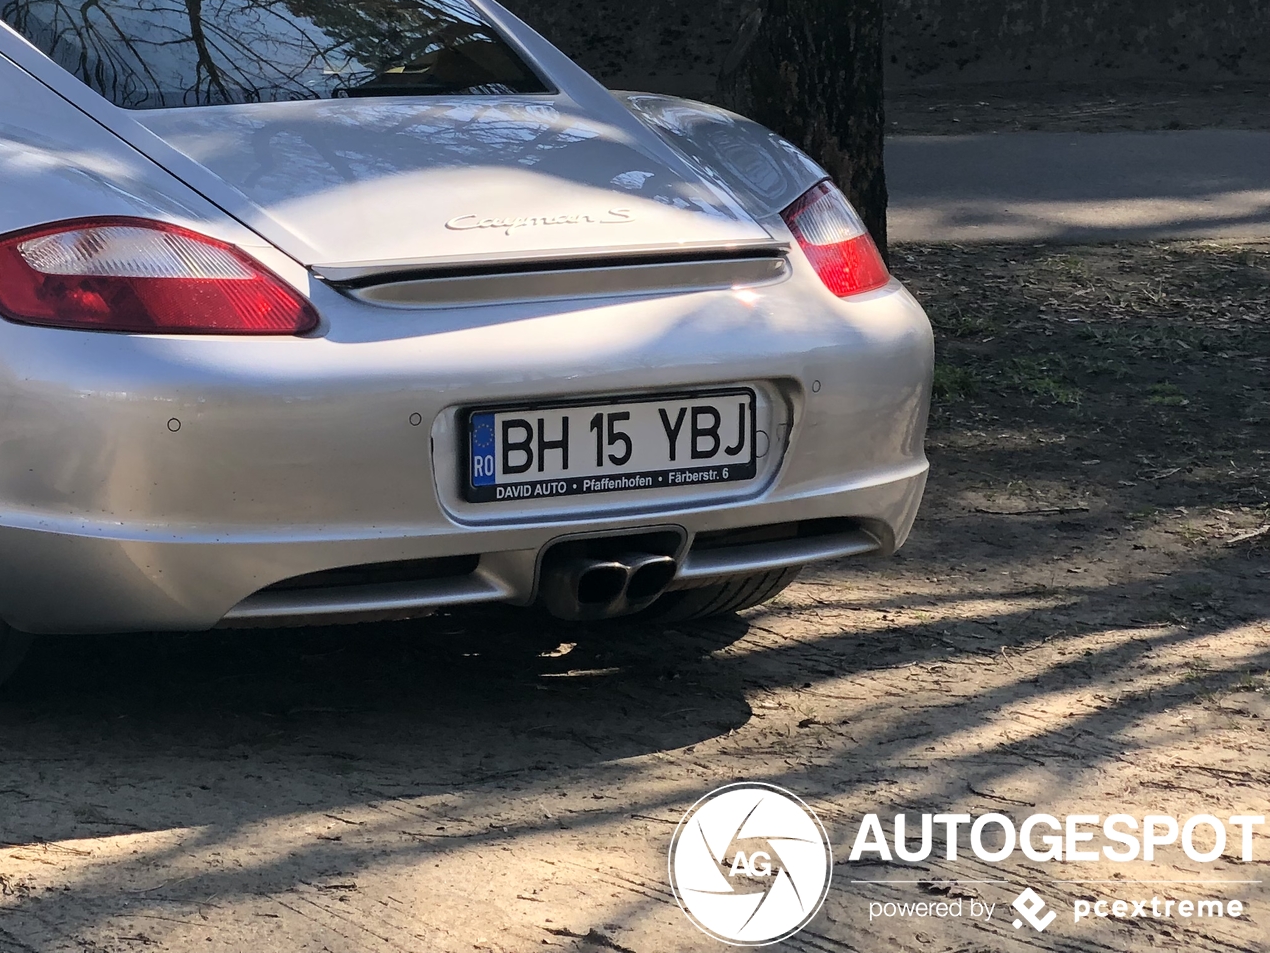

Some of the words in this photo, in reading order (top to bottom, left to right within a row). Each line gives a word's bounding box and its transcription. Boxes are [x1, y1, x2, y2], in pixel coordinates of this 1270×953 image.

[444, 214, 595, 236] Cayman
[600, 207, 636, 224] S
[501, 416, 569, 475] BH
[590, 411, 633, 467] 15
[658, 403, 746, 461] YBJ
[474, 454, 493, 478] RO
[496, 485, 532, 499] DAVID
[534, 481, 567, 495] AUTO
[583, 475, 652, 491] Pfaffenhofen
[668, 469, 719, 484] Färberstr.
[723, 468, 729, 479] 6
